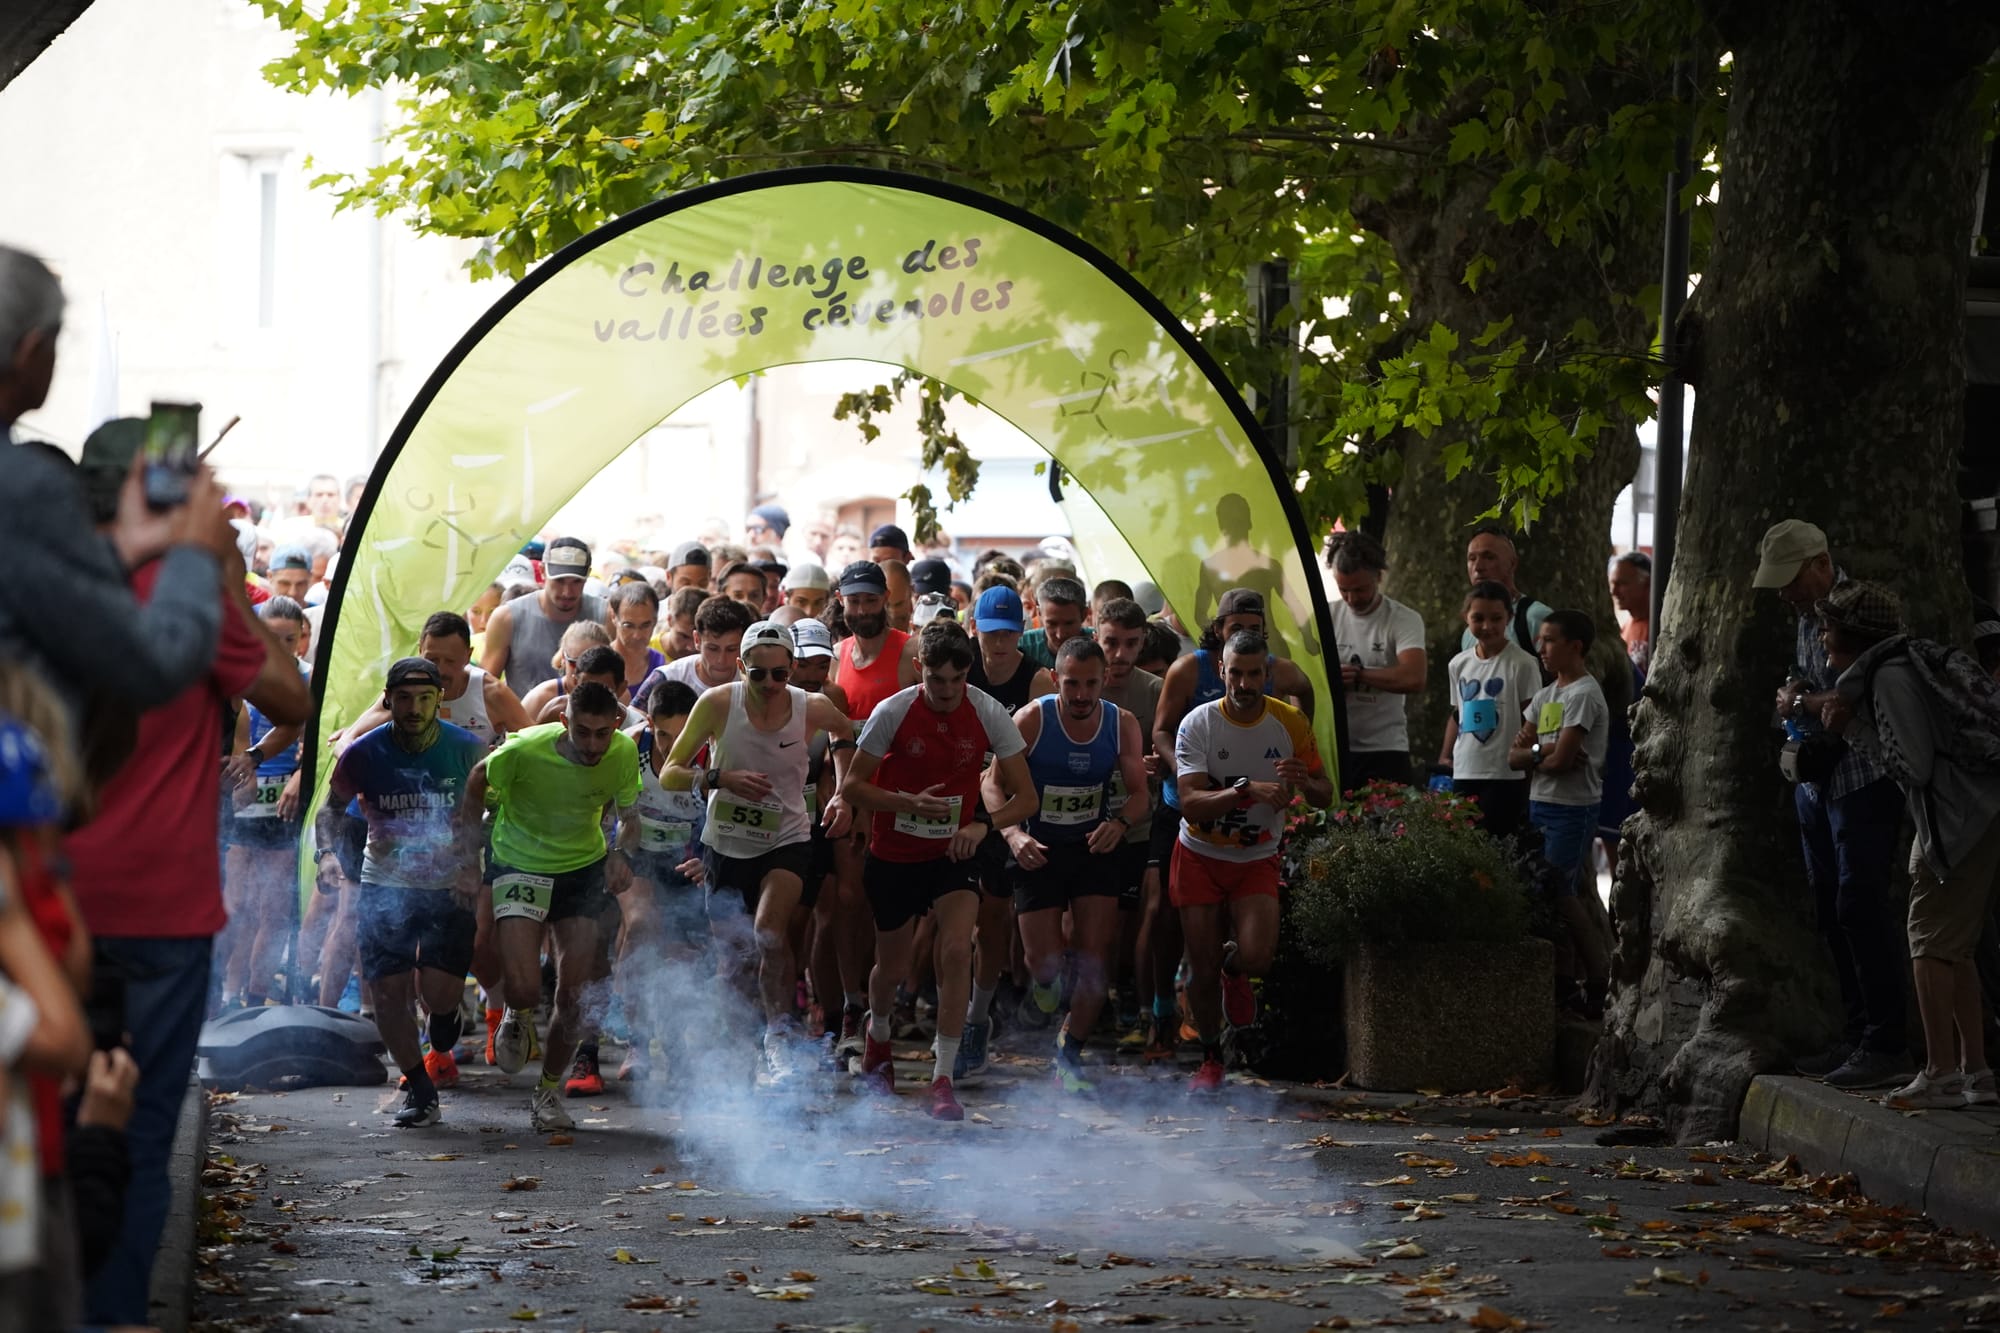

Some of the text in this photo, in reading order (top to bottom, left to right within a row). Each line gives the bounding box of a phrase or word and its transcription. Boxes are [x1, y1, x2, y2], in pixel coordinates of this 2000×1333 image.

[618, 239, 981, 299] Challenge des
[594, 281, 1013, 342] vallées cévenoles
[1473, 711, 1482, 724] 5
[1052, 795, 1095, 812] 134
[732, 806, 763, 827] 53
[505, 884, 535, 904] 43
